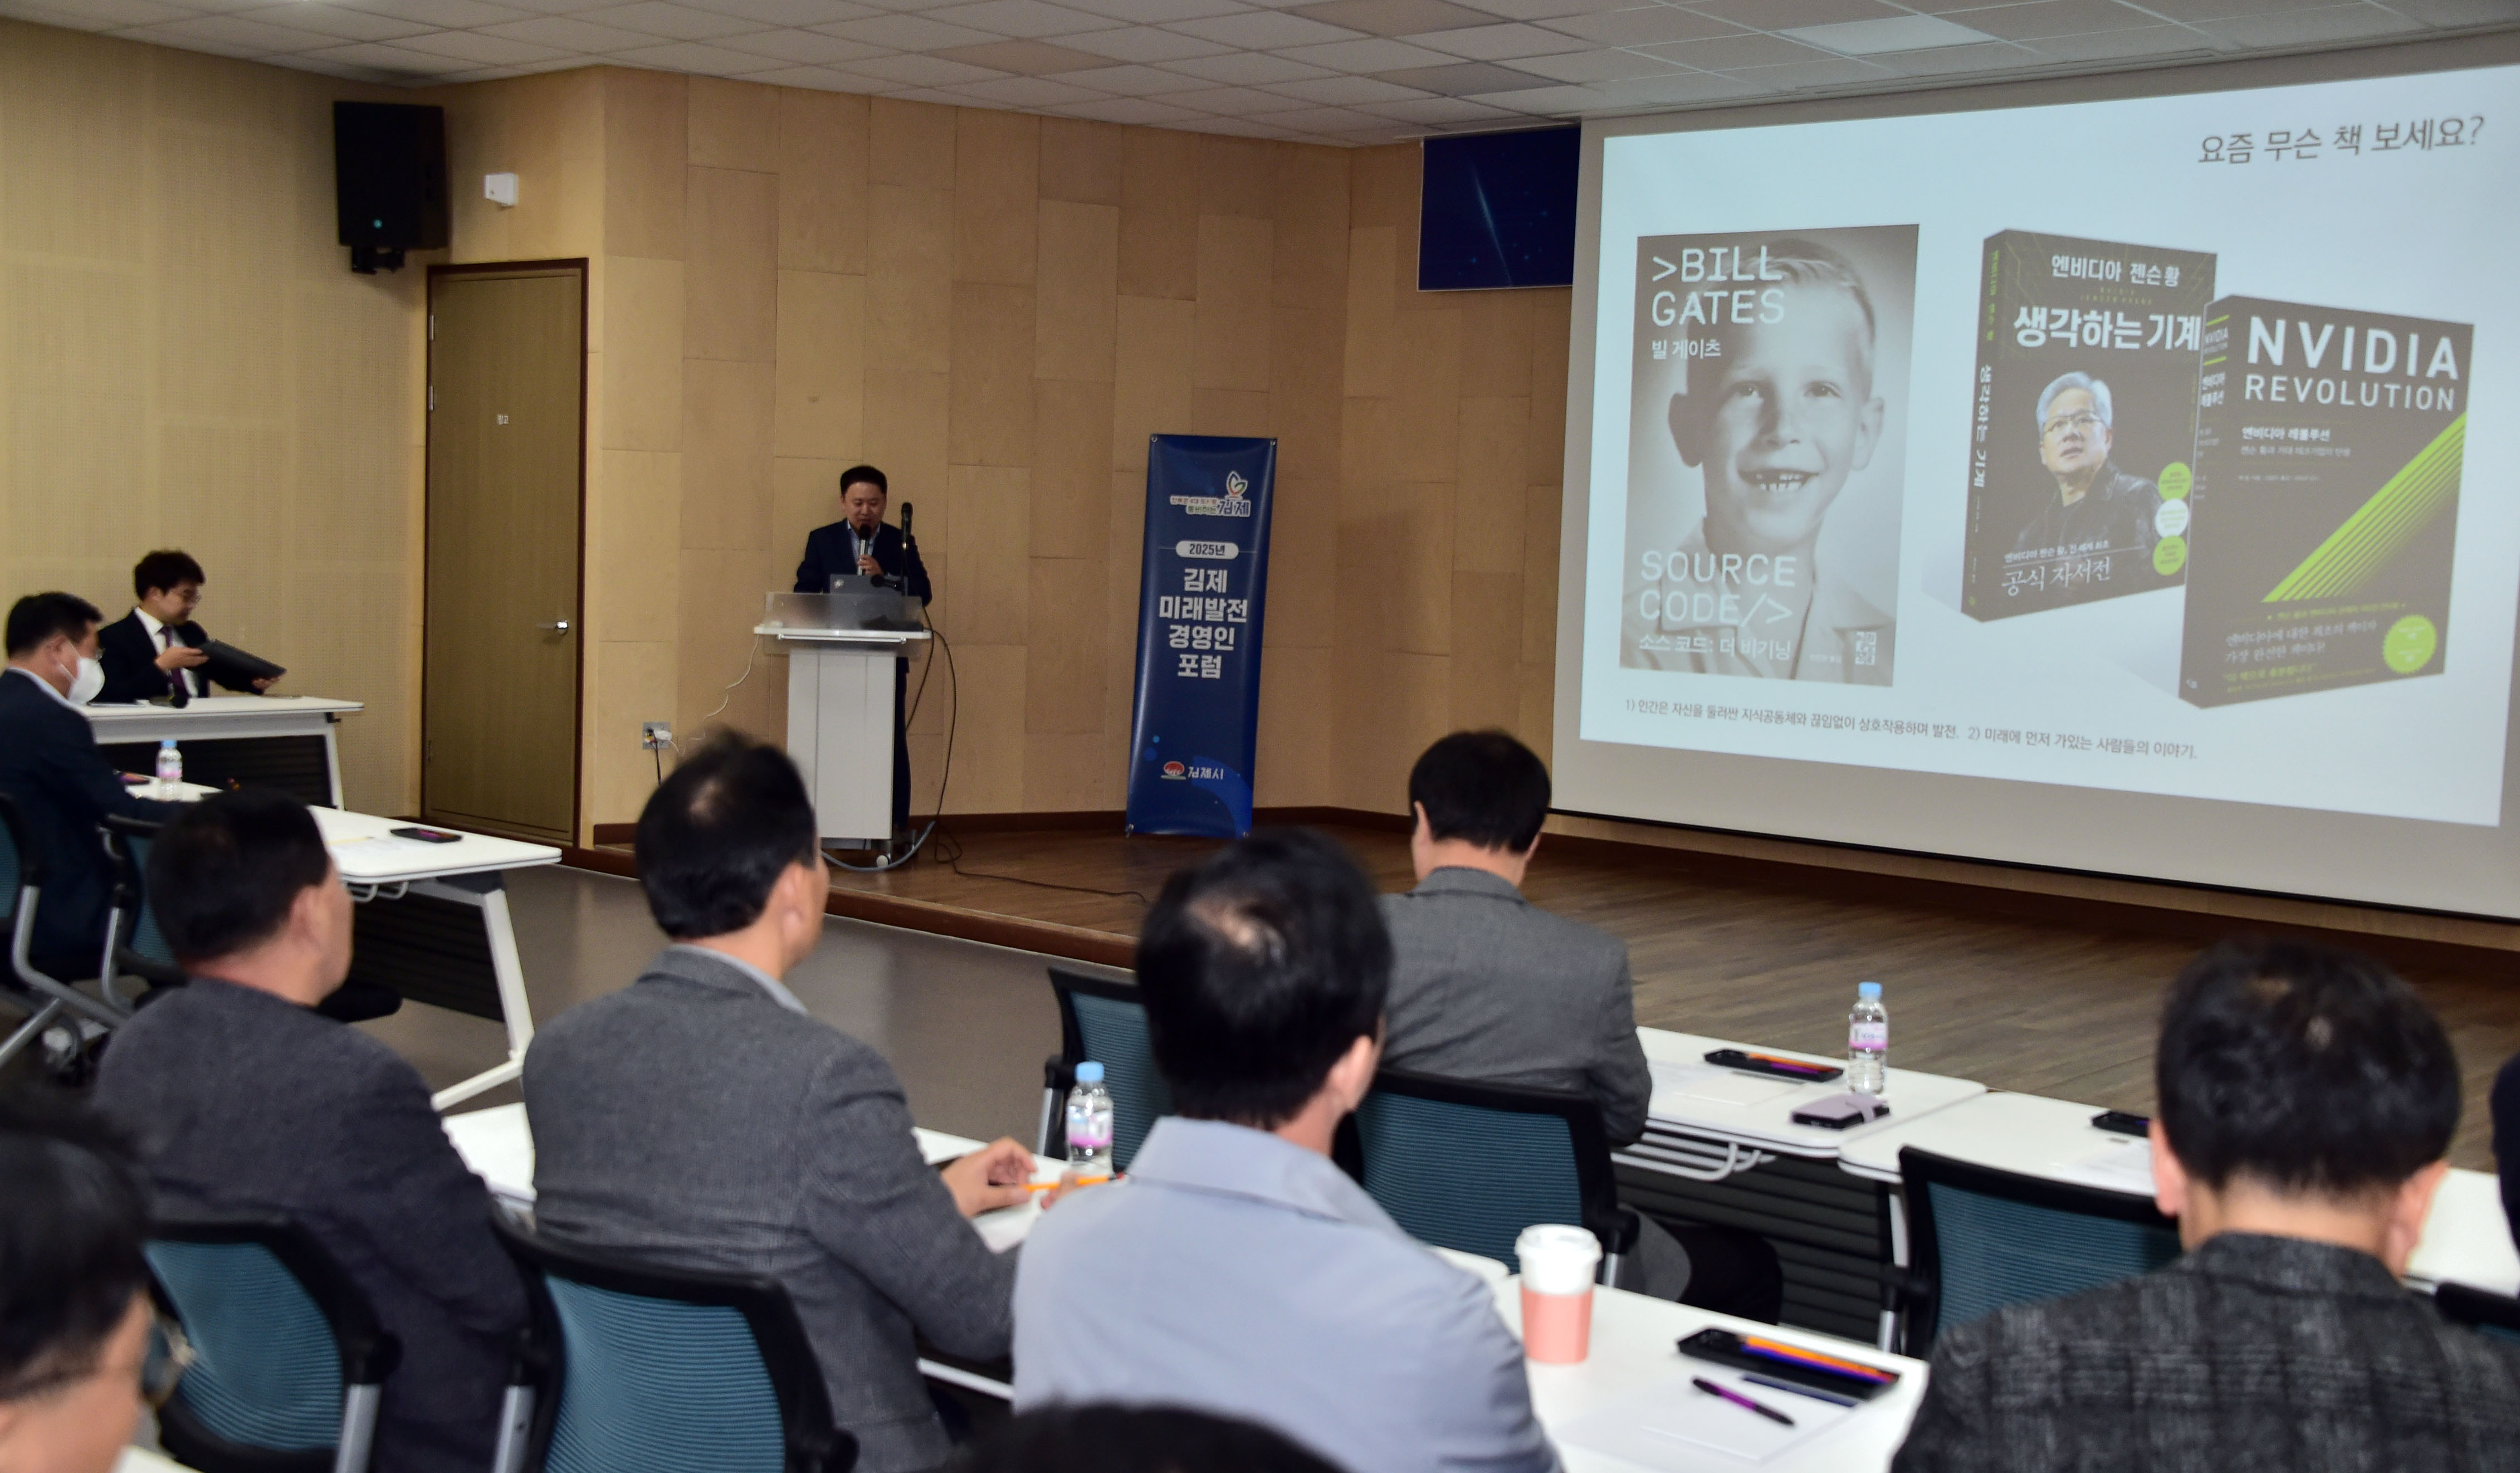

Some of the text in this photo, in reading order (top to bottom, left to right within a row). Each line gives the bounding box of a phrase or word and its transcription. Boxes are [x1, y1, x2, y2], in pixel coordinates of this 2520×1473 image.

[2198, 116, 2484, 164] 요즘 무슨 책 보세요?
[2051, 255, 2122, 282] 엔비디아
[2130, 263, 2162, 286] 젠슨
[1652, 289, 1784, 326] GATES
[2013, 306, 2201, 351] 생각하는 기계
[1652, 339, 1721, 359] 빌 게이츠
[2247, 315, 2459, 380] NVIDIA
[2244, 373, 2454, 412] REVOLUTION
[1974, 364, 1992, 487] 생각하는 기계
[1218, 500, 1249, 515] 김제
[1189, 544, 1225, 556] 2025년
[1184, 568, 1228, 593] 김제
[1641, 550, 1797, 587] SOURCE
[2001, 565, 2045, 597] 공식
[2050, 556, 2111, 587] 자서전
[1159, 596, 1248, 623] 미래발전
[1169, 625, 1234, 651] 경영인
[1639, 635, 1670, 651] 소스
[1675, 636, 1713, 653] 코드:
[1720, 636, 1735, 657] 더
[1741, 638, 1791, 660] 비기닝
[1178, 654, 1222, 679] 포럼
[1625, 699, 2197, 759] 1) 인간은 자신을 둘러싼 지식공동체와 끊임없이 상호작용하며 발전. 2) 미래에 먼저 가있는 사람들의 이야기.
[1188, 766, 1223, 780] 김제시
